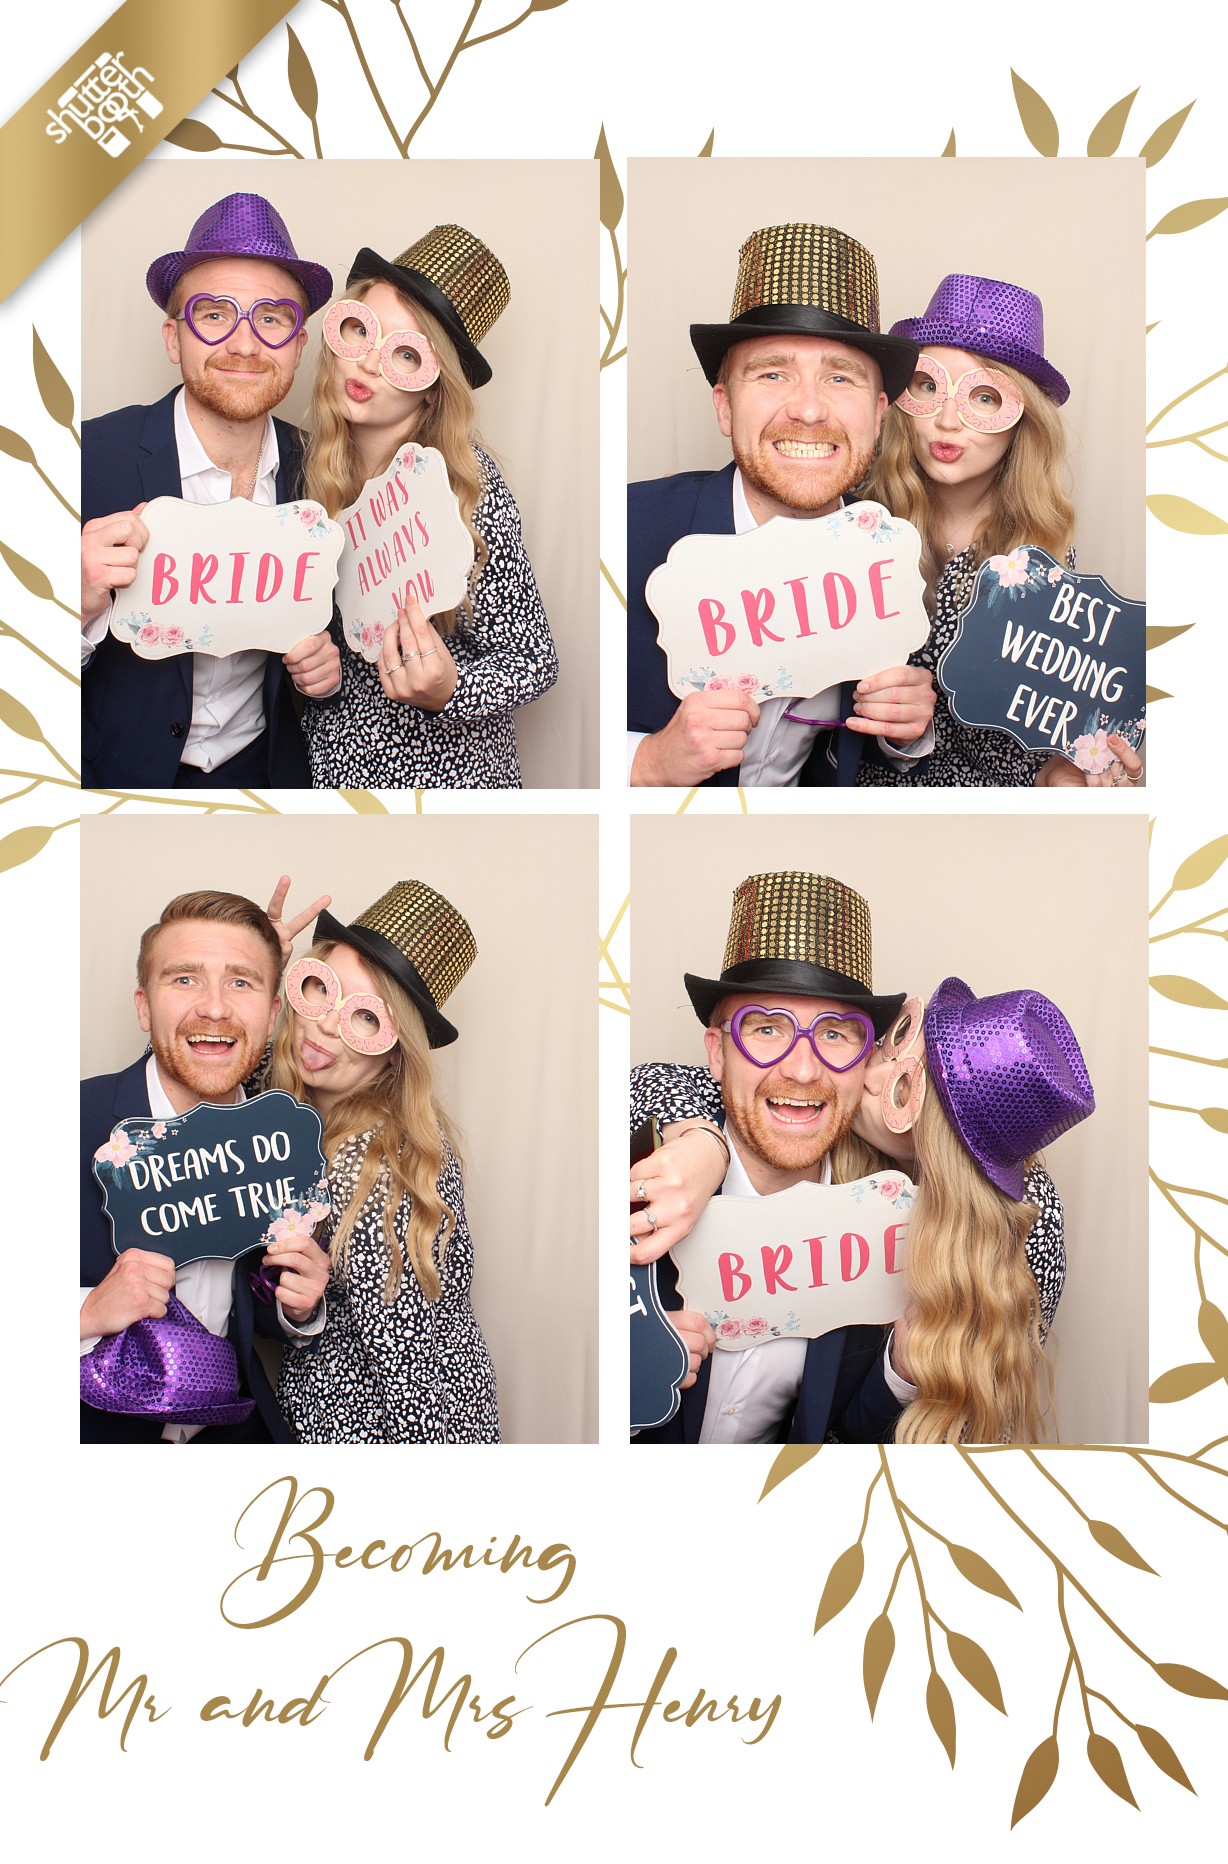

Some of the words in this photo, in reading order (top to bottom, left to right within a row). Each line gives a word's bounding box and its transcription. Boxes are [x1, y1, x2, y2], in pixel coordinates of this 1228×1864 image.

[345, 508, 367, 551] IT
[369, 471, 409, 528] WAS
[151, 551, 320, 606] BRIDE
[357, 511, 430, 596] ALWAYS
[391, 569, 435, 609] YOU
[697, 558, 901, 657] BRIDE
[1049, 583, 1121, 646] BEST
[1001, 620, 1128, 703] WEDDING
[1006, 683, 1078, 747] EVER
[128, 1139, 245, 1192] DREAMS
[252, 1131, 291, 1163] DO
[140, 1193, 222, 1236] COME
[228, 1176, 299, 1219] TRUE
[717, 1222, 911, 1303] BRIDE
